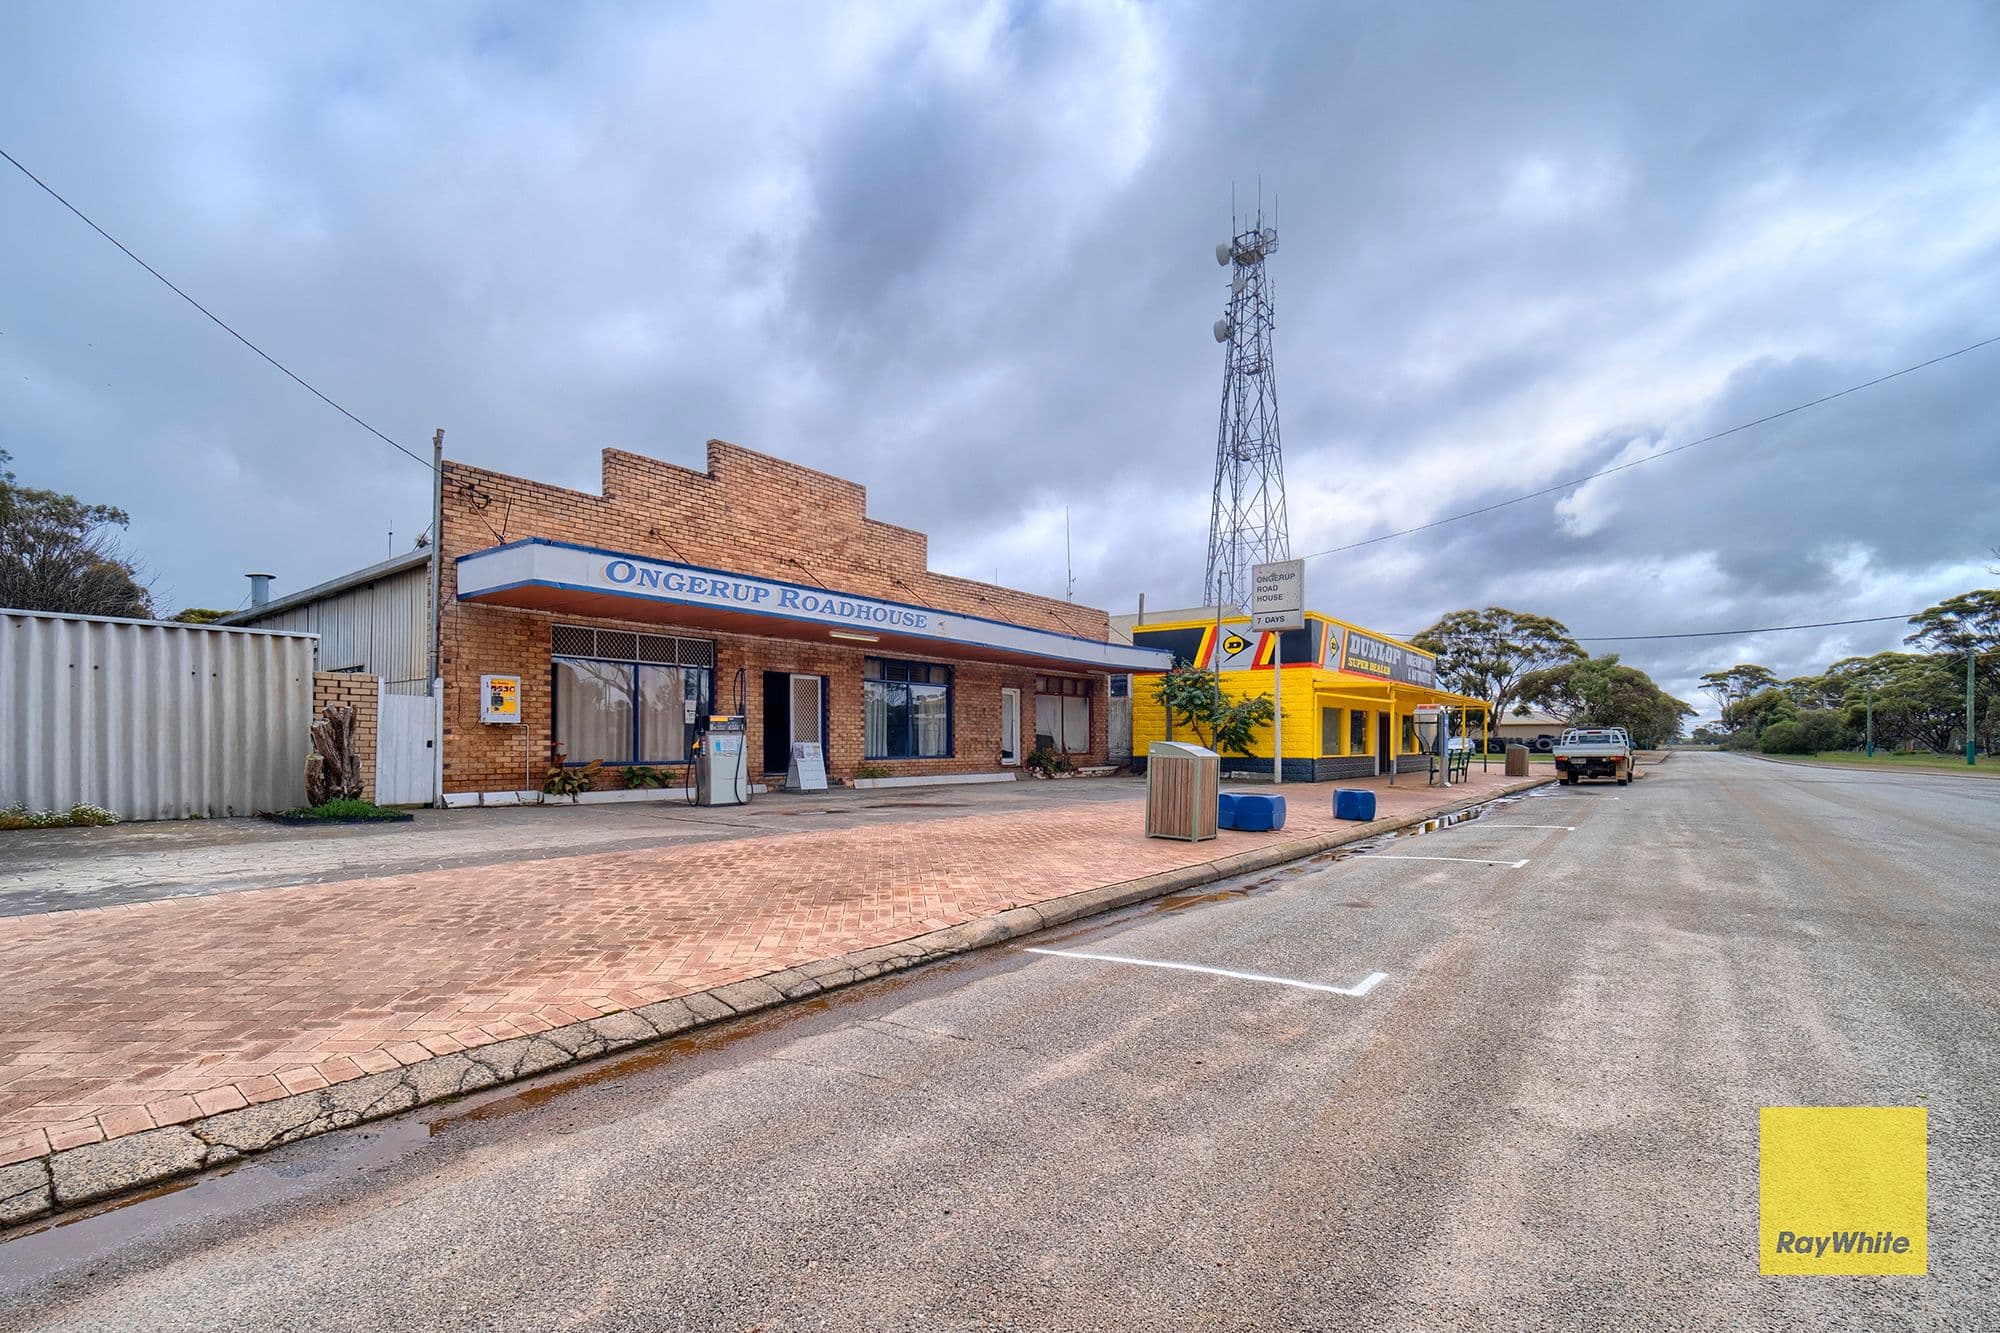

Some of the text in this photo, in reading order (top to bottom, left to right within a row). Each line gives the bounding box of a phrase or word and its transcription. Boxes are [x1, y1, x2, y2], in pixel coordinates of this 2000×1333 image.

[1256, 572, 1296, 583] ONGERUP
[1256, 584, 1279, 593] ROAD
[605, 560, 928, 629] ONGERUP ROADHOUSE
[1256, 593, 1284, 603] HOUSE
[1257, 615, 1286, 625] 7 DAYS
[1349, 634, 1401, 665] DUNLOP
[1347, 657, 1369, 671] SUPER
